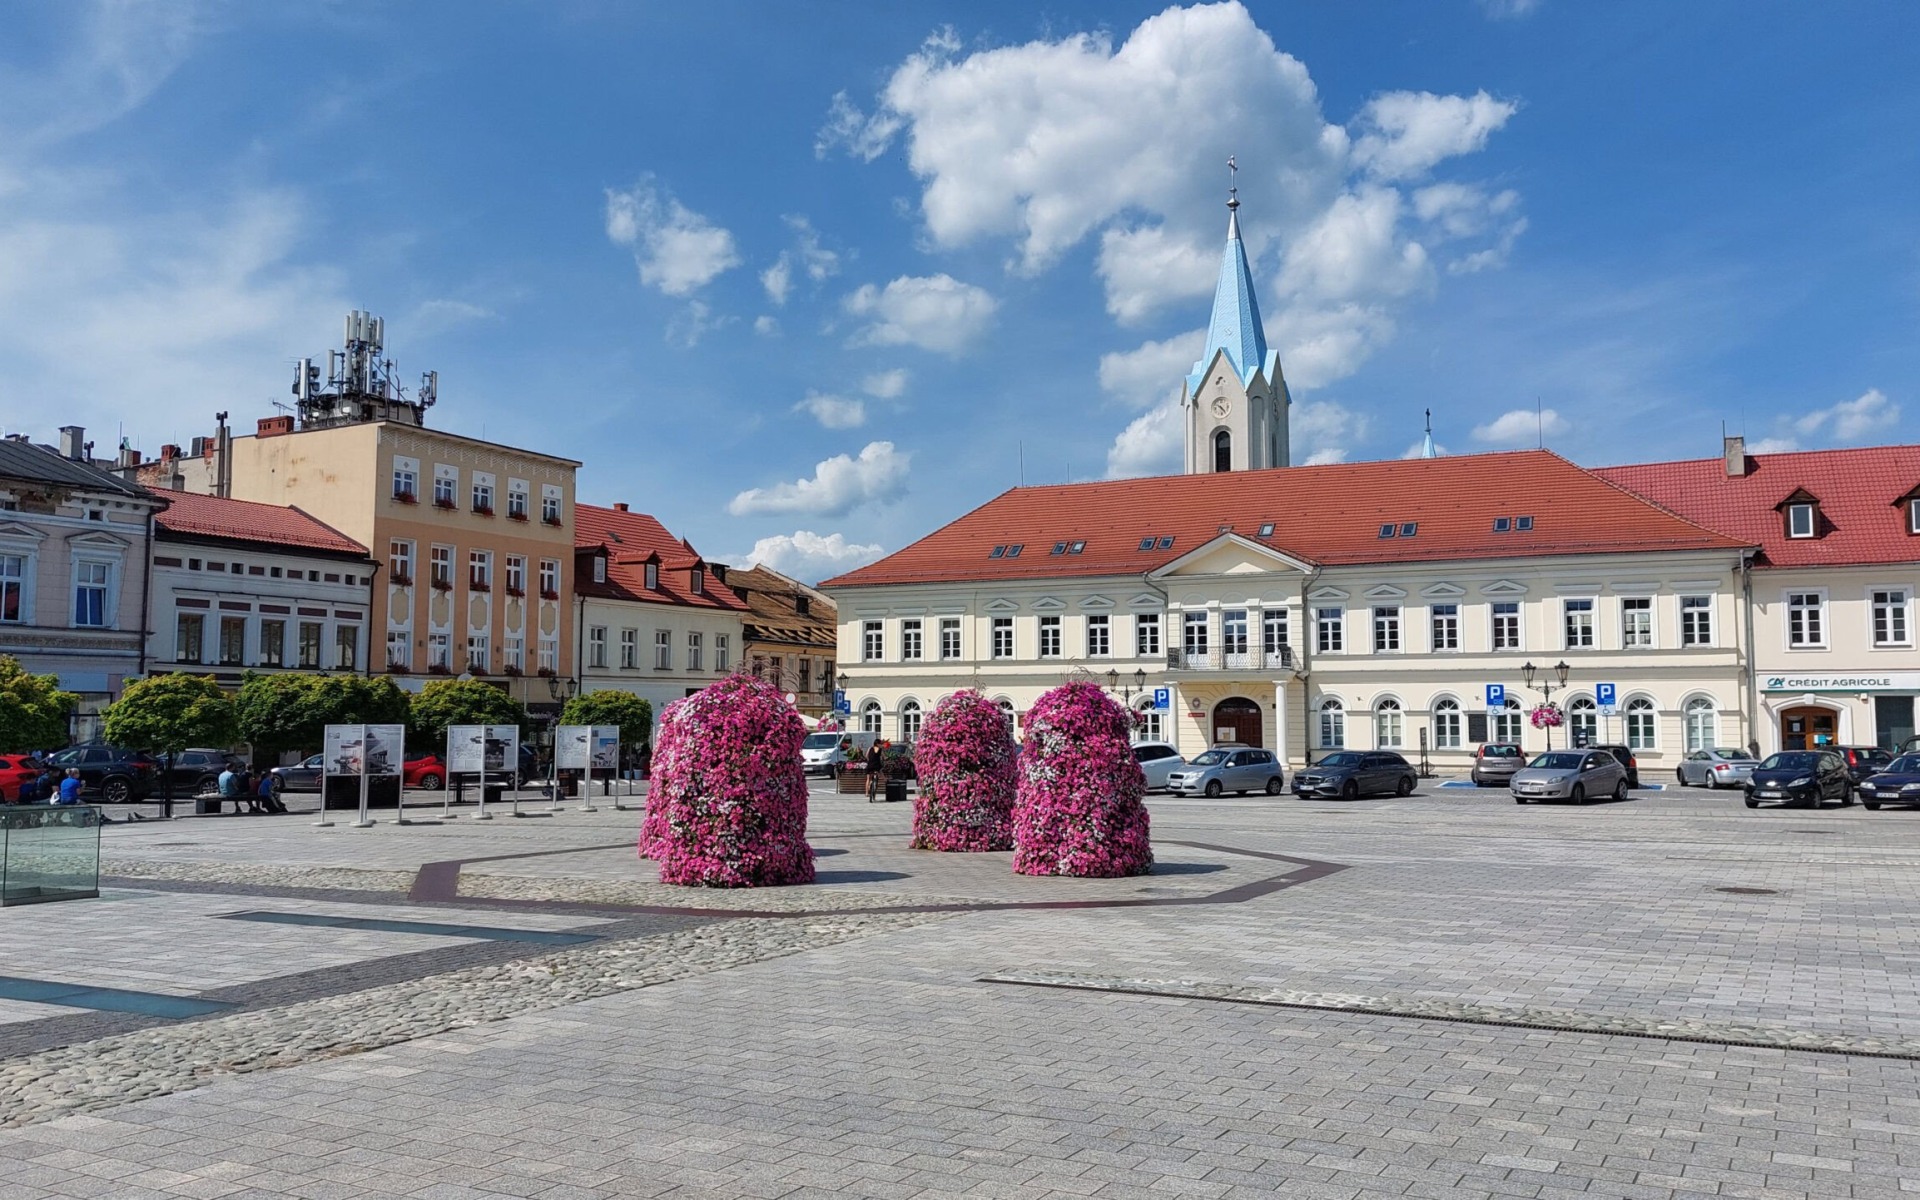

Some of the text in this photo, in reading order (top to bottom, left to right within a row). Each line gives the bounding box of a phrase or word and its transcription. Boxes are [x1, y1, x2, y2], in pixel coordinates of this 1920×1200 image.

[1788, 678, 1830, 687] CRÉDIT
[1832, 678, 1891, 687] AGRICOLE
[1158, 690, 1166, 703] P
[1490, 686, 1500, 699] P
[1601, 685, 1611, 699] P
